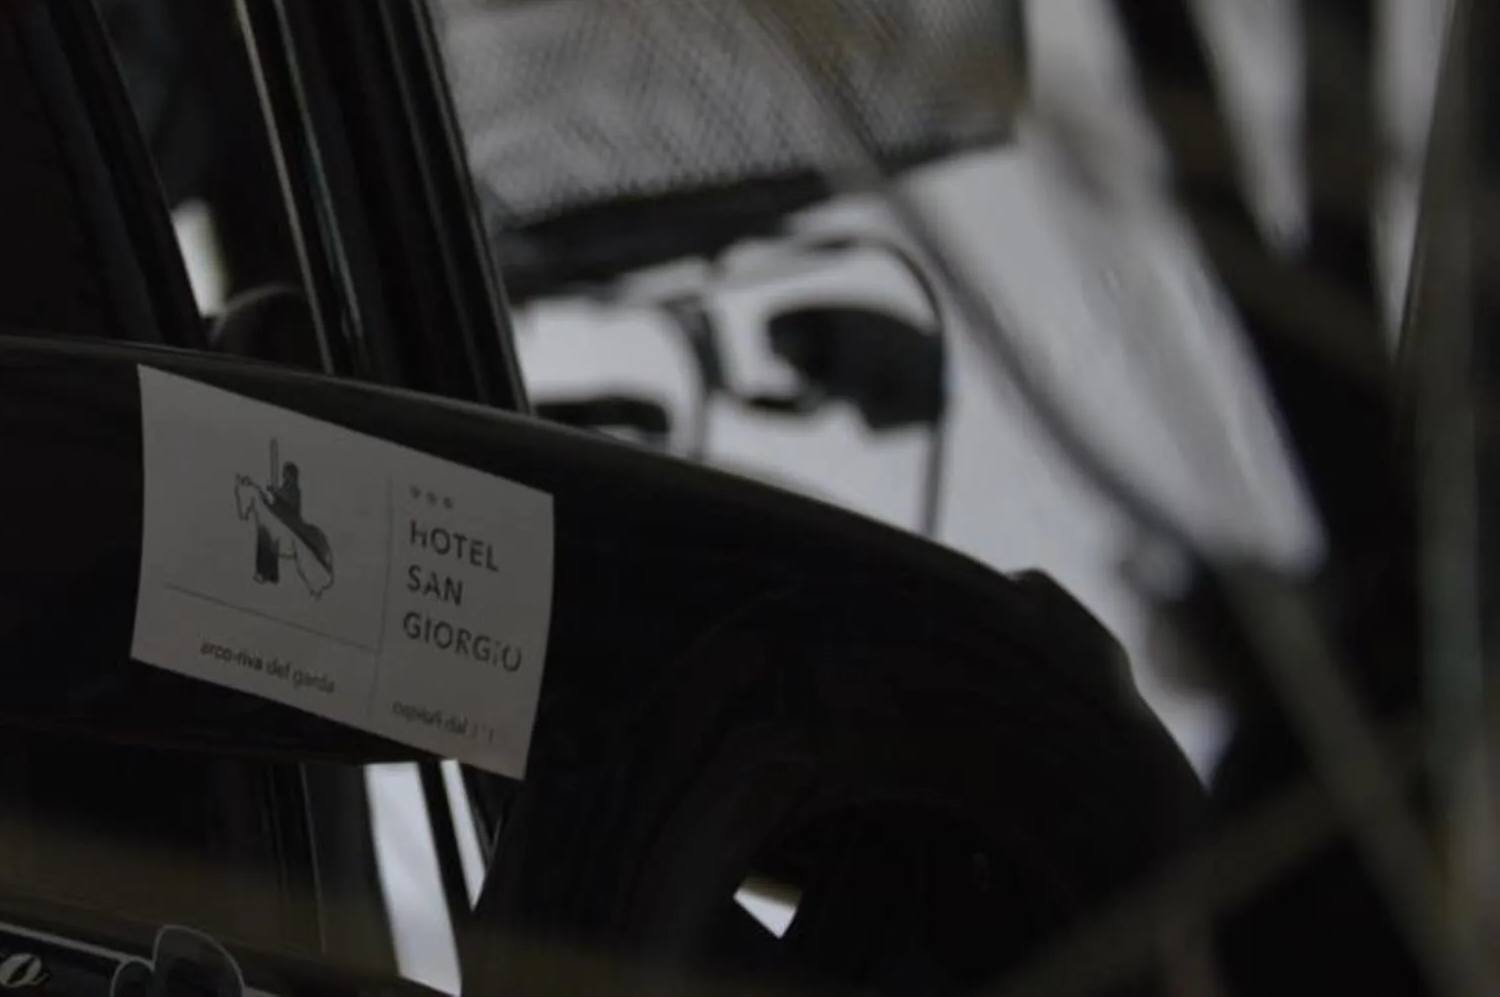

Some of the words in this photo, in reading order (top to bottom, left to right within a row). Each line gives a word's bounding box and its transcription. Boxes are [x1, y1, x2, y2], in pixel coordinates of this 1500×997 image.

[410, 519, 500, 572] HOTEL
[407, 564, 463, 607] SAN
[402, 611, 522, 672] GIORGIO
[266, 657, 292, 680] del
